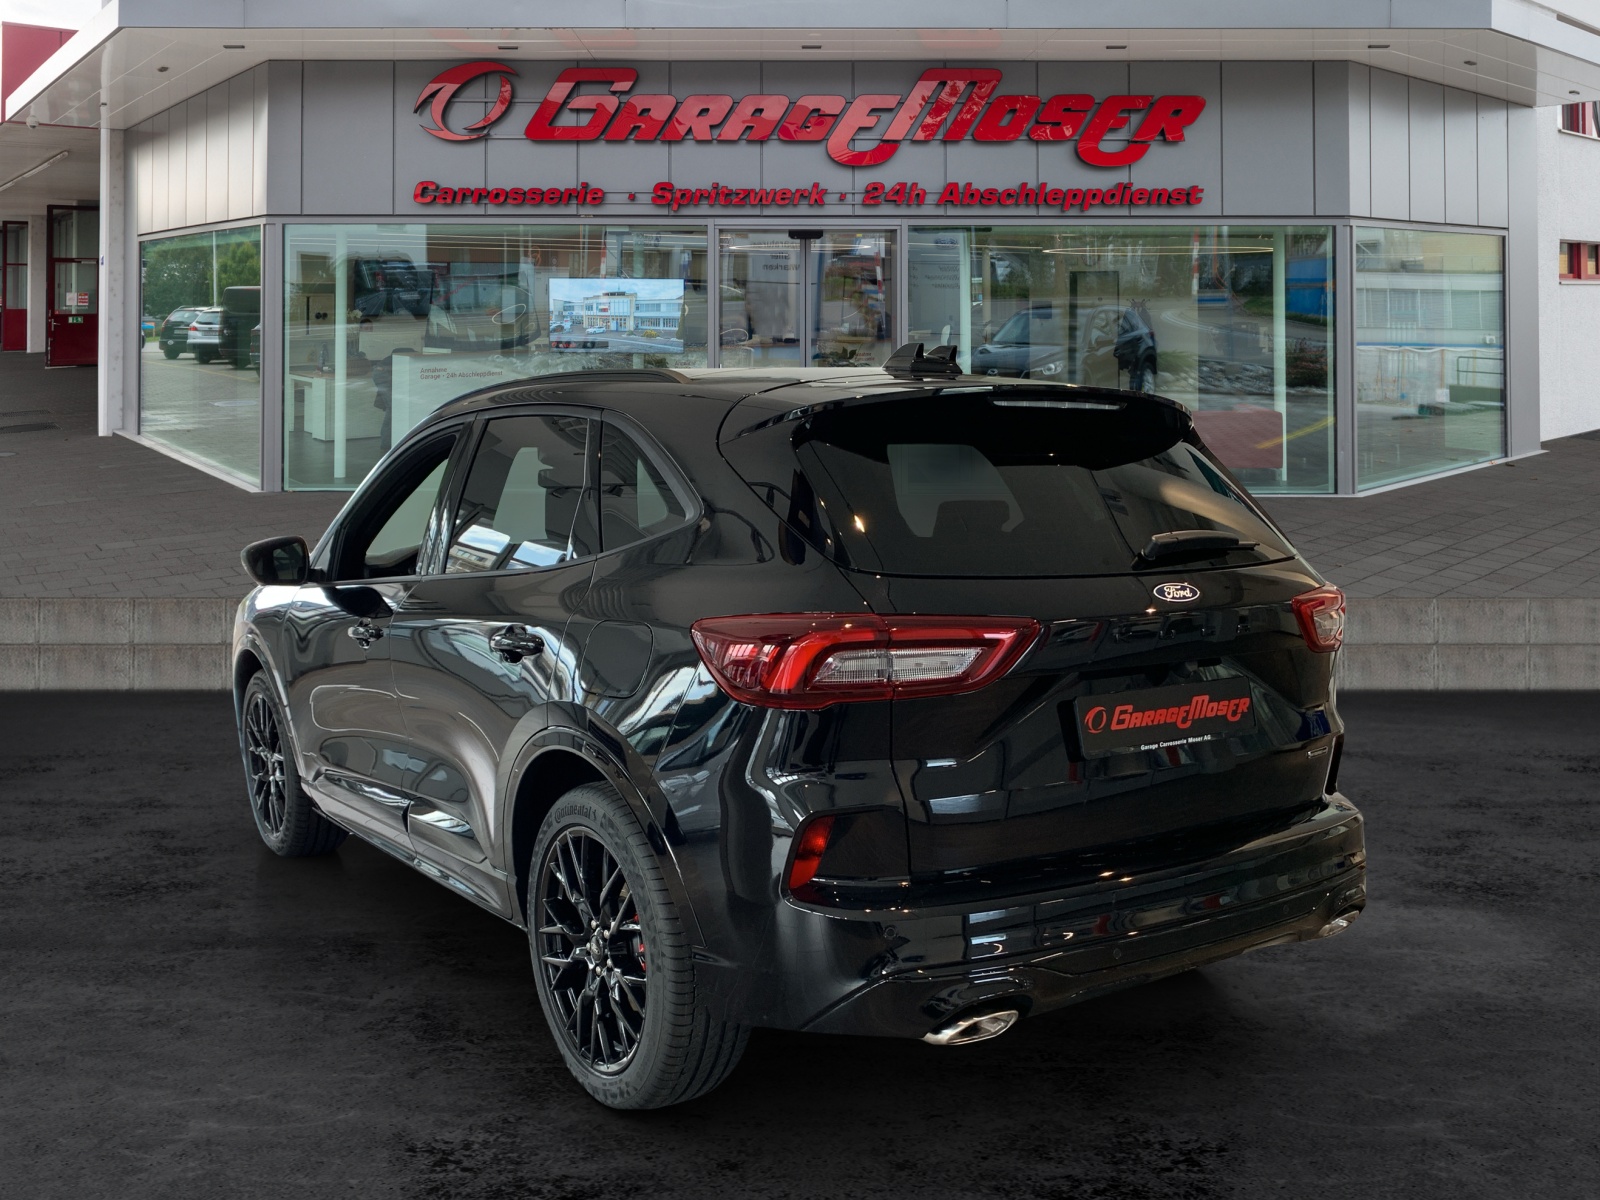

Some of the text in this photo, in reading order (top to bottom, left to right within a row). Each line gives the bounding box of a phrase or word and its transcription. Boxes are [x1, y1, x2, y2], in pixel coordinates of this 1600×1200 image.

[413, 181, 1205, 211] Carrosserie Spritzwerk 24h Abschleppdienst
[1163, 585, 1193, 598] Ford
[554, 802, 592, 824] Continental
